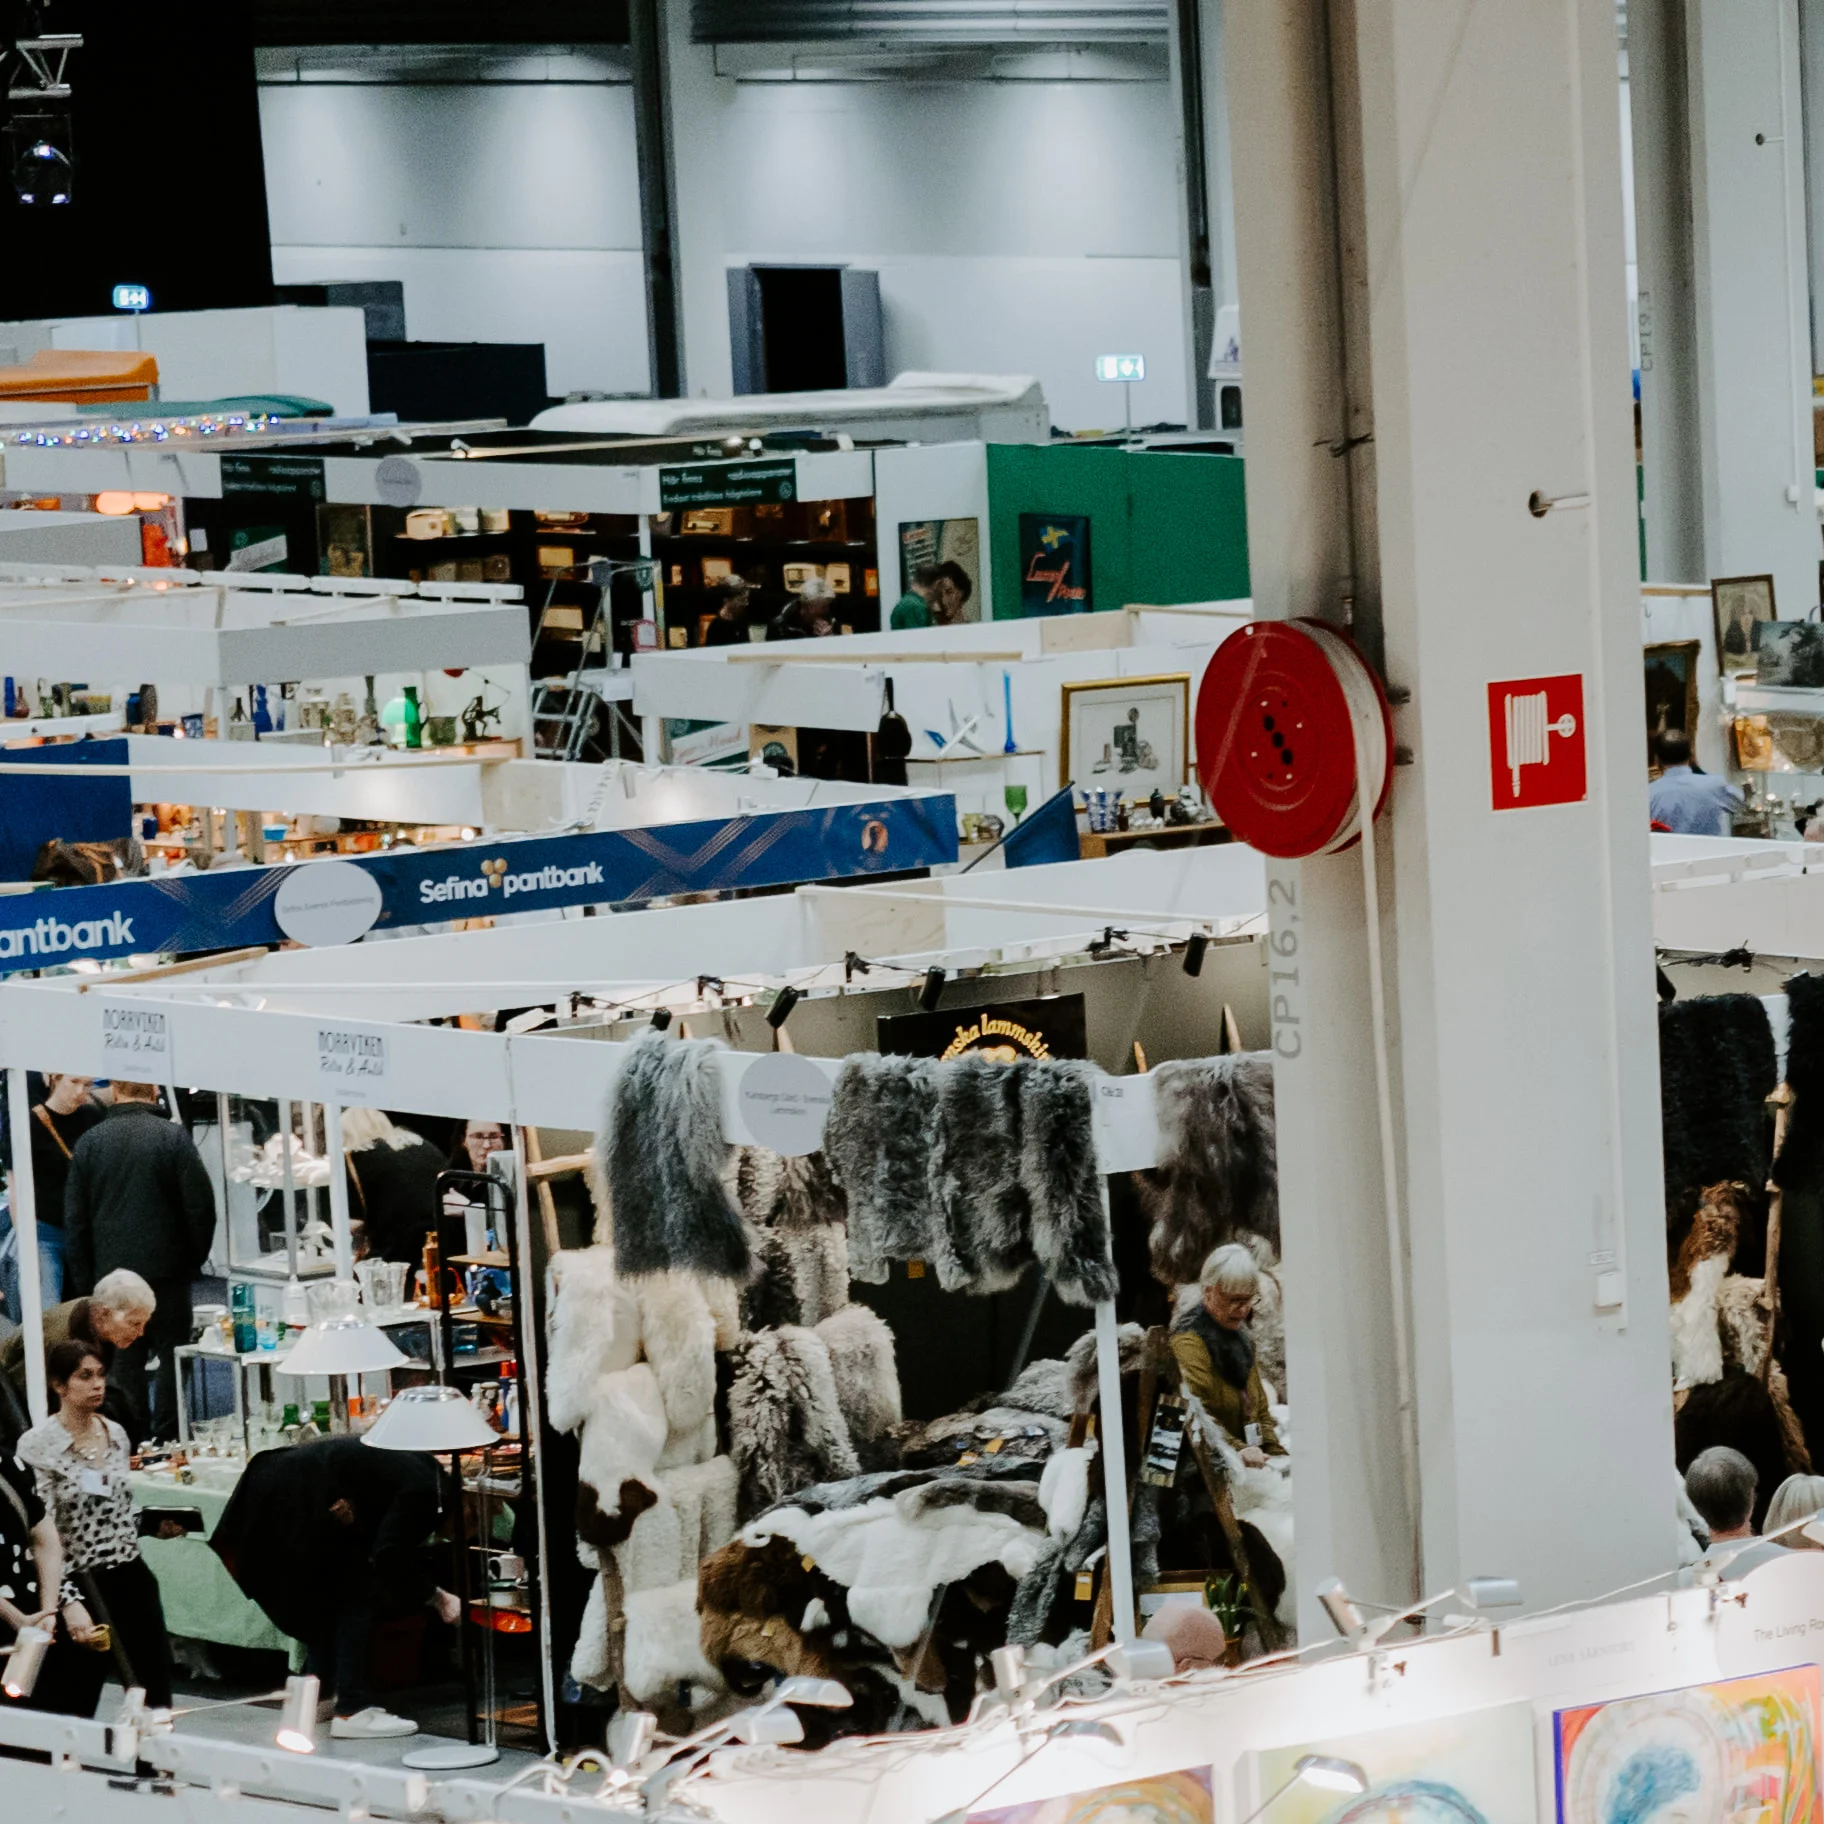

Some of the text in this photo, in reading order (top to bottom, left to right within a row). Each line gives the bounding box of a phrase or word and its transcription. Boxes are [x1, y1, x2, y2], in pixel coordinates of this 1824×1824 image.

[419, 860, 606, 904] Sefina pantbank
[1268, 877, 1303, 1061] CP16,2
[1753, 1629, 1774, 1643] The
[1775, 1623, 1807, 1639] Living
